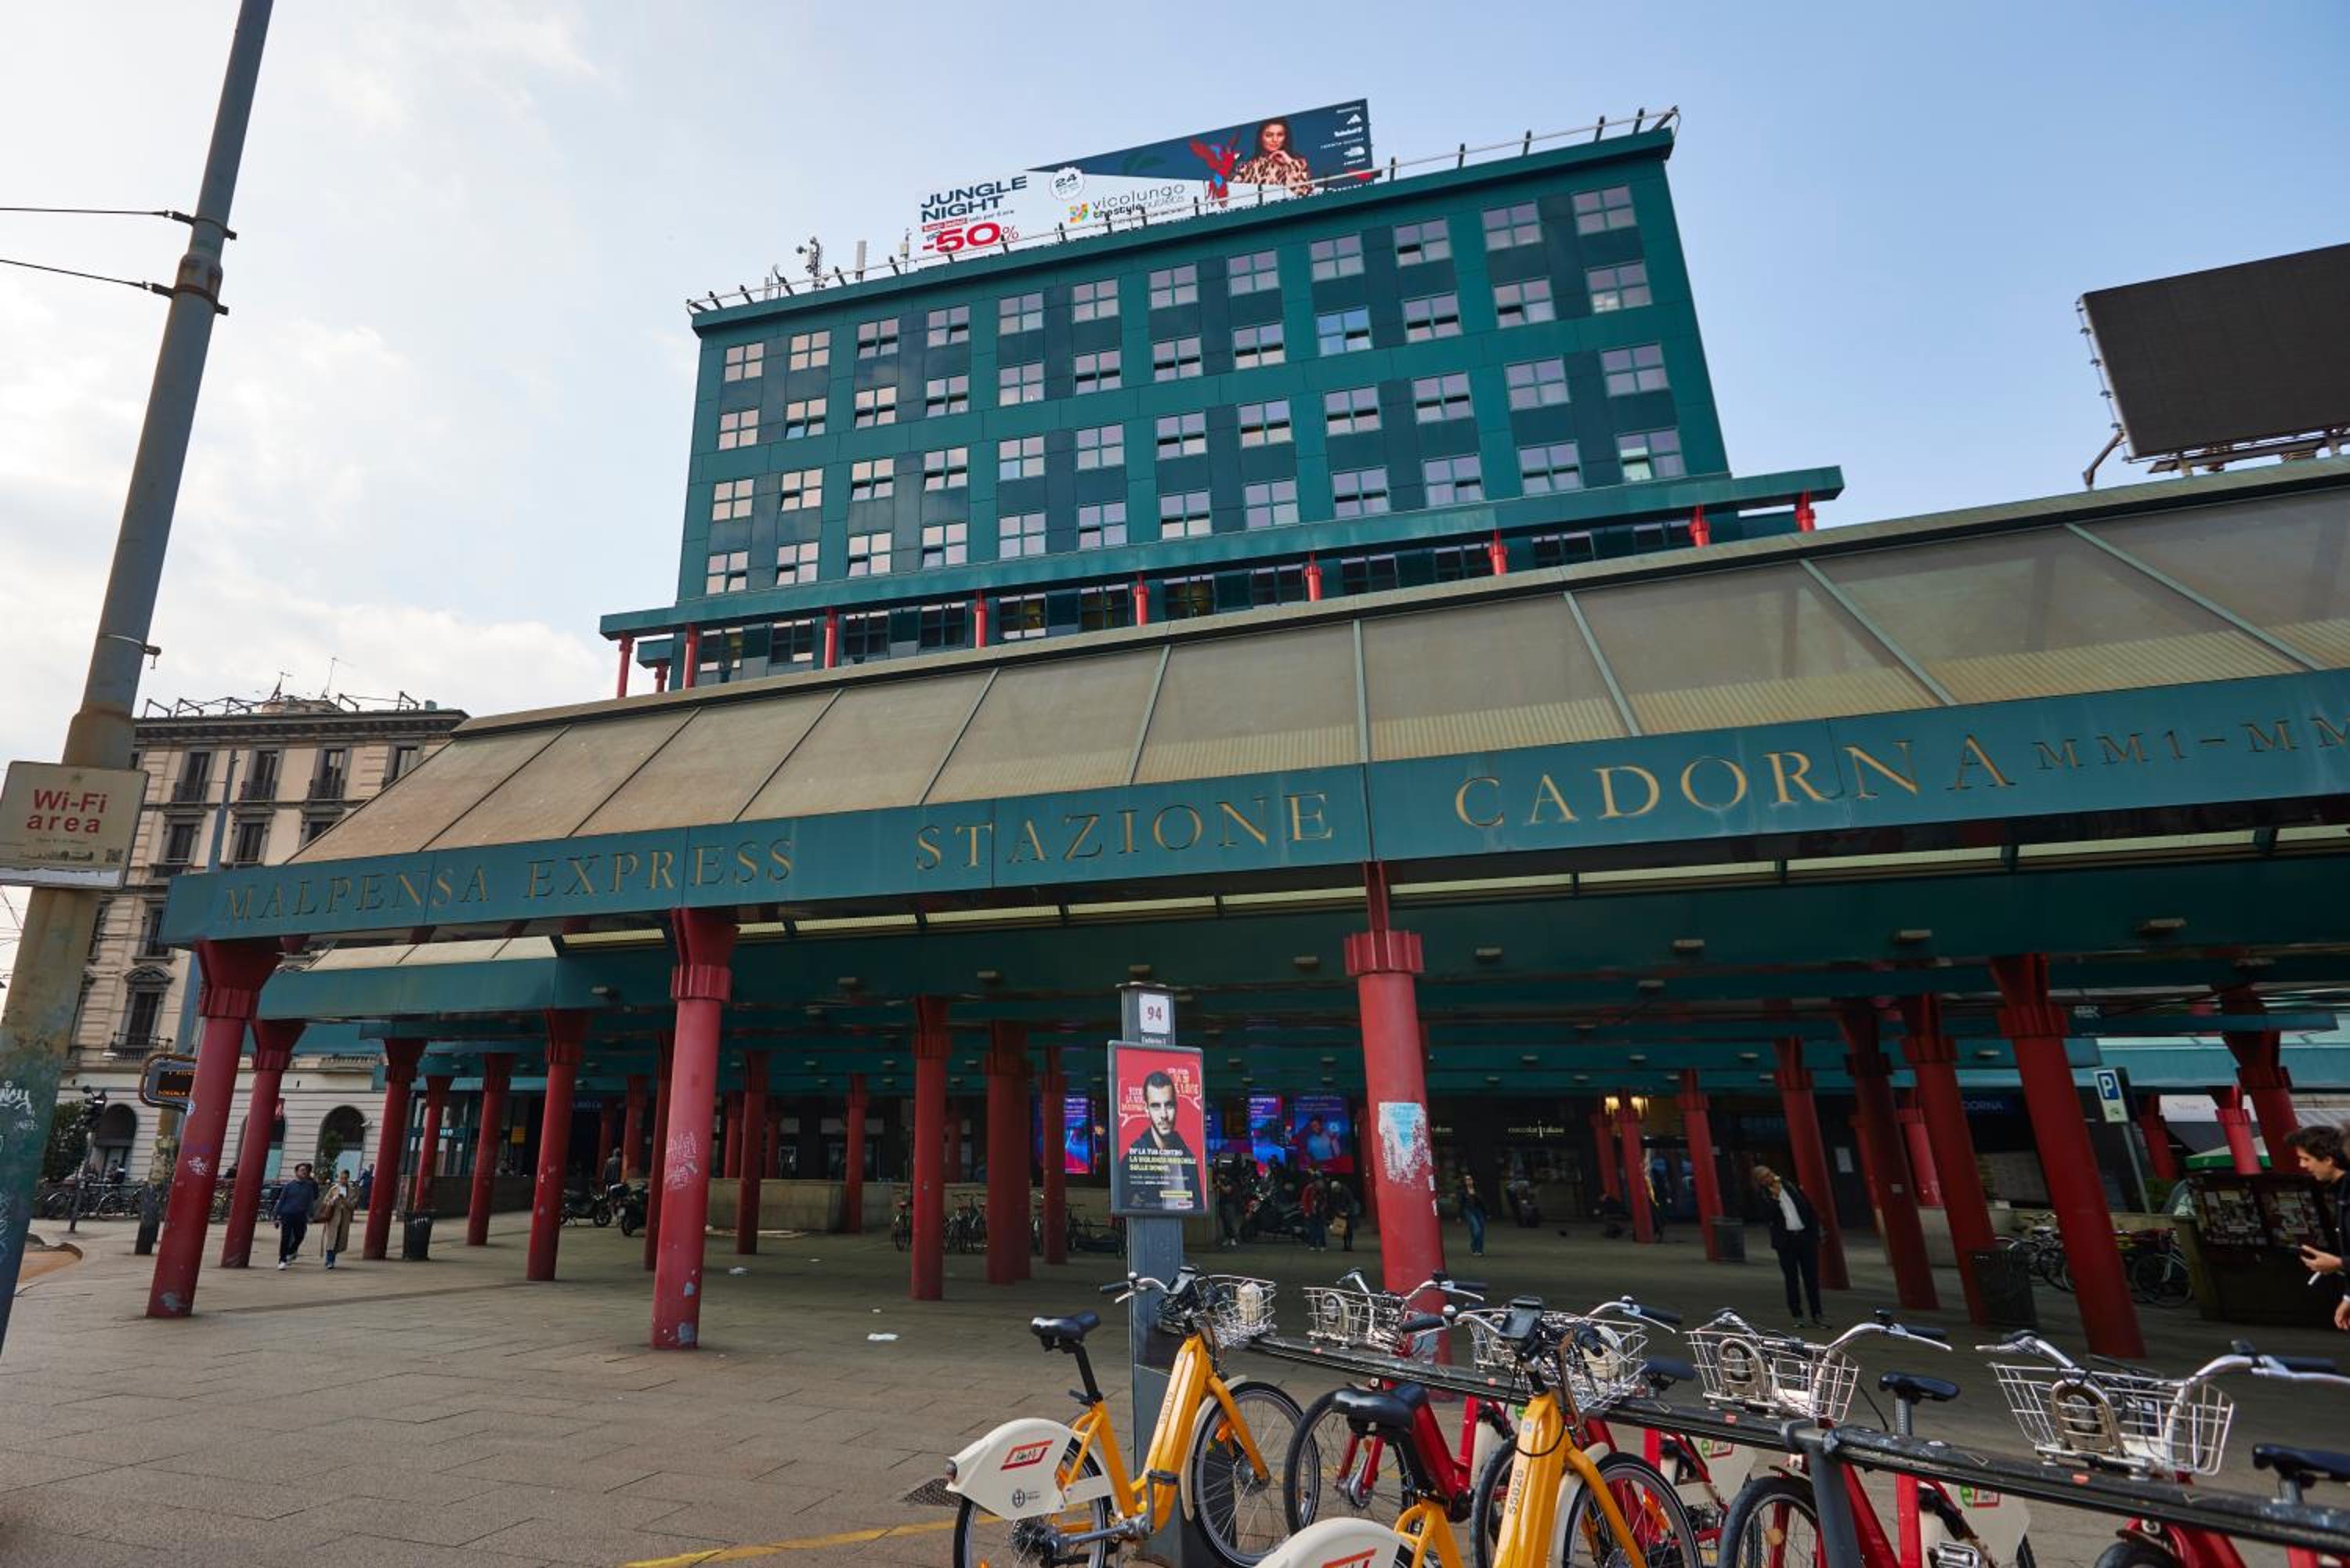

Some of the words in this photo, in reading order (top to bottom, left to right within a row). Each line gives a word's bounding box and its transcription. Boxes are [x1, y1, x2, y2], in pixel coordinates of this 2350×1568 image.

[921, 175, 1027, 208] JUNGLE
[1093, 184, 1185, 210] vicolungo
[922, 194, 1004, 223] NIGHT
[34, 789, 108, 813] Wi-Fi
[27, 813, 101, 833] area
[221, 864, 489, 923] MALPENSA
[524, 839, 794, 900] EXPRESS
[916, 792, 1333, 870] STAZIONE
[1455, 734, 2016, 828] CADORNA
[1148, 1006, 1162, 1021] 94
[2100, 1075, 2113, 1097] P
